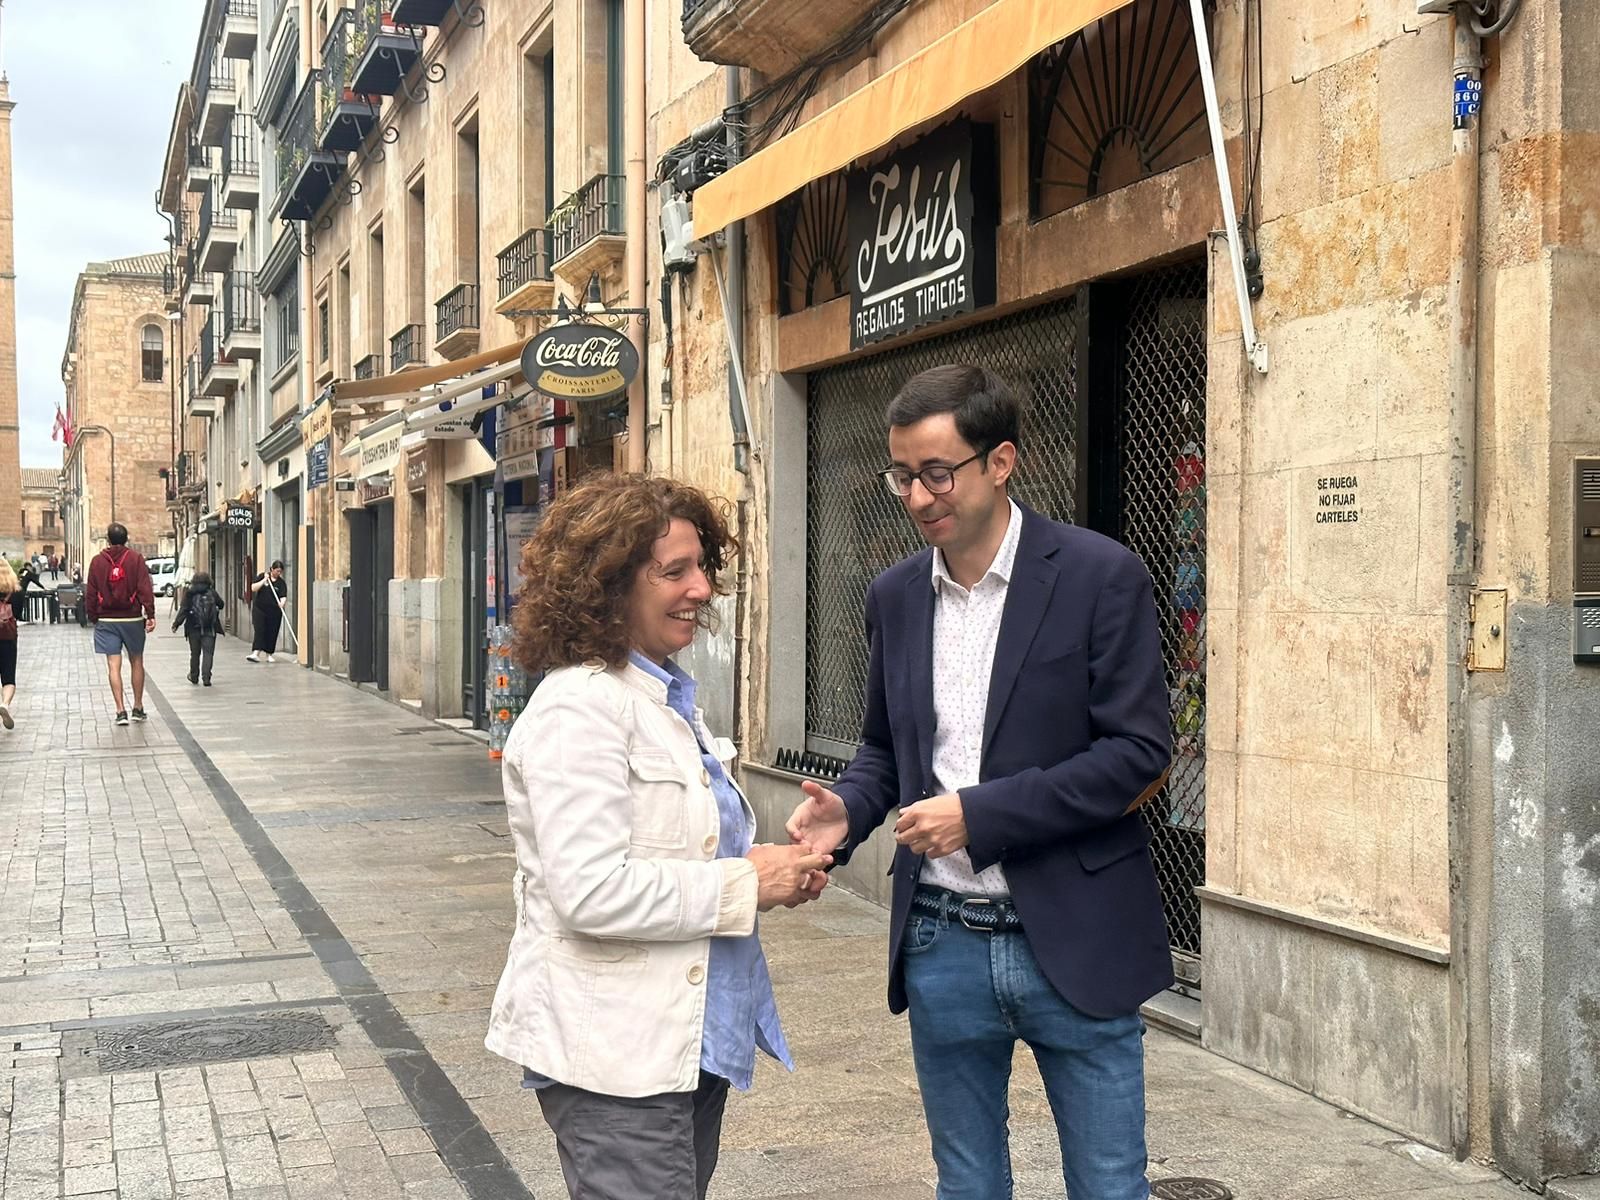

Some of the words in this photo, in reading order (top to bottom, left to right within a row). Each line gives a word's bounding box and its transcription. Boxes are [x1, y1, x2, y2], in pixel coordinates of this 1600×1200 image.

[856, 297, 905, 338] REGALOS
[916, 274, 966, 317] TIPICOS
[536, 336, 623, 368] Coca-Cola
[546, 374, 617, 387] CROISSANTERIA
[1317, 478, 1328, 490] SE
[1329, 476, 1358, 490] RUEGA
[1319, 495, 1331, 506] NO
[1332, 493, 1356, 506] FIJAR
[1316, 510, 1359, 524] CARTELES
